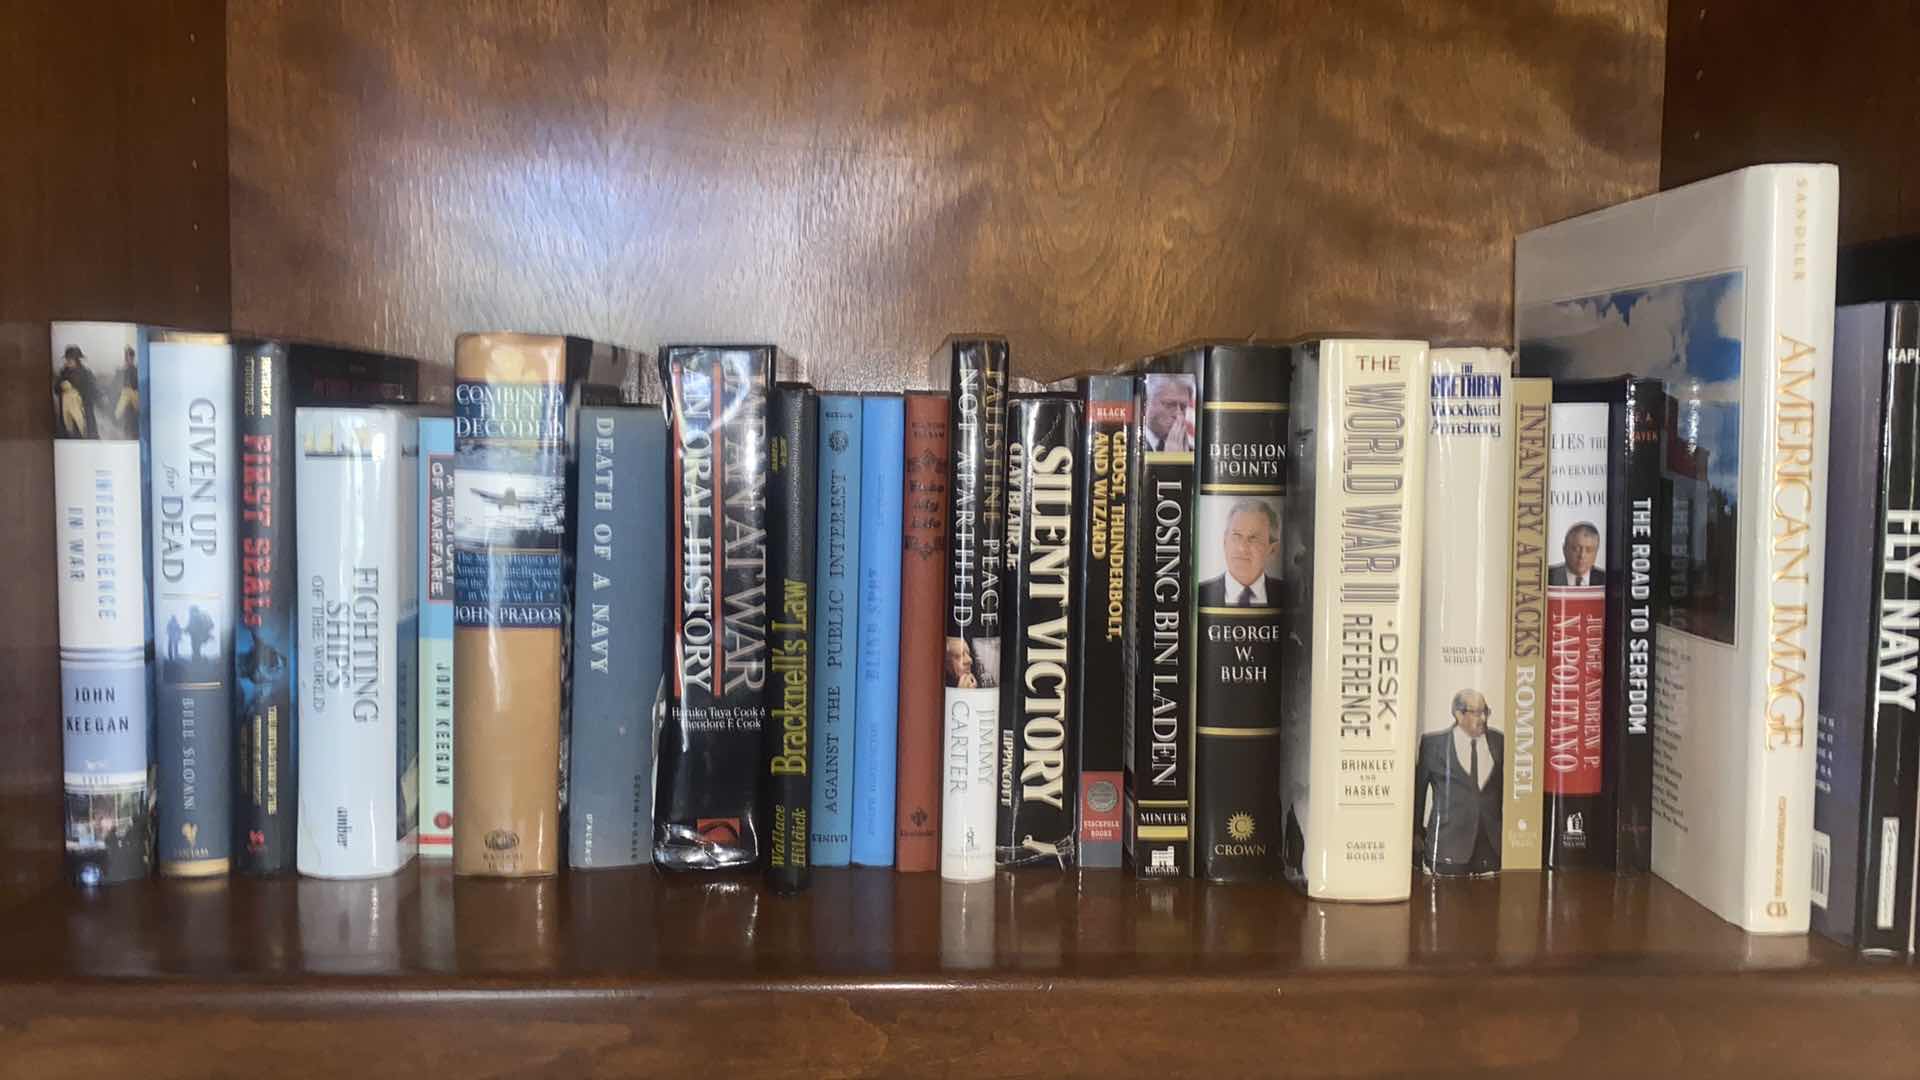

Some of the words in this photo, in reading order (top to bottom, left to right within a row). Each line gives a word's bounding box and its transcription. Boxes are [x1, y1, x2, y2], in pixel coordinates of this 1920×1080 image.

[1794, 178, 1808, 280] SANDLER
[456, 384, 565, 405] COMBINED
[683, 368, 712, 419] AN
[1356, 355, 1401, 372] THE
[1430, 374, 1502, 398] BRETHREN
[456, 417, 564, 438] DECODED
[957, 366, 978, 432] NOT
[1096, 407, 1127, 417] BLACK
[1429, 420, 1502, 438] Armstrong
[1430, 403, 1501, 418] Woodward
[188, 397, 216, 503] GIVEN
[594, 417, 614, 510] DEATH
[724, 367, 766, 510] JAPAN
[983, 370, 1004, 523] PALESTINE
[1008, 442, 1024, 490] CLAY
[1093, 431, 1110, 475] AND
[1110, 431, 1127, 500] GHOST,
[1209, 443, 1287, 458] DECISION
[1216, 461, 1279, 476] POINTS
[1343, 382, 1406, 494] WORLD
[1517, 403, 1547, 536] INFANTRY
[1773, 331, 1817, 585] AMERICAN
[162, 463, 181, 489] for
[242, 434, 272, 527] FIRST
[430, 462, 444, 491] OF
[684, 432, 712, 527] ORAL
[67, 507, 85, 529] IN
[95, 470, 117, 619] INTELLIGENCE
[160, 495, 184, 583] DEAD
[188, 513, 216, 557] UP
[429, 496, 444, 596] WARFARE
[593, 523, 612, 560] OF
[724, 516, 766, 580] AT
[829, 471, 847, 578] INTEREST
[953, 450, 977, 627] APARTHEID
[1029, 445, 1073, 608] SILENT
[1092, 478, 1109, 560] WIZARD
[1154, 480, 1183, 603] LOSING
[1340, 504, 1403, 575] WAR
[1632, 497, 1652, 538] THE
[1884, 509, 1920, 581] FLY
[69, 540, 86, 582] WAR
[312, 575, 325, 599] OF
[592, 572, 611, 590] A
[980, 538, 1000, 626] PEACE
[1105, 503, 1127, 642] THUNDERBOLT,
[1631, 544, 1651, 600] ROAD
[455, 606, 494, 623] JOHN
[500, 606, 561, 624] PRADOS
[683, 536, 712, 692] HISTORY
[772, 579, 809, 632] Law
[827, 588, 845, 669] PUBLIC
[1513, 541, 1543, 657] ATTACKS
[1630, 605, 1650, 632] TO
[326, 600, 350, 689] SHIPS
[352, 567, 379, 722] FIGHTING
[590, 603, 609, 674] NAVY
[724, 580, 766, 695] WAR
[1153, 611, 1180, 666] BIN
[1208, 625, 1280, 641] GEORGE
[1584, 613, 1602, 673] JUDGE
[1877, 600, 1920, 713] NAVY
[75, 687, 116, 701] JOHN
[312, 645, 326, 713] WORLD
[436, 664, 451, 708] JOHN
[827, 686, 841, 723] THE
[1221, 666, 1268, 682] BUSH
[1340, 613, 1373, 738] REFERENCE
[1377, 632, 1400, 720] DESK
[1550, 613, 1582, 774] NAPOLITANO
[1628, 638, 1649, 735] SERFDOM
[1764, 602, 1809, 751] IMAGE
[66, 716, 129, 732] KEEGAN
[182, 698, 195, 739] BILL
[680, 719, 726, 730] heodore
[736, 718, 761, 729] Cook
[708, 706, 732, 719] Taya
[733, 706, 759, 718] Cook
[771, 640, 808, 776] Bracknell's
[1020, 616, 1069, 811] VICTORY
[1151, 674, 1179, 788] LADEN
[1513, 664, 1537, 801] ROMMEL
[1583, 676, 1603, 749] ANDREW
[183, 746, 196, 810] SLOAN
[436, 718, 451, 785] KEEGAN
[824, 732, 841, 814] AGAINST
[949, 700, 970, 794] CARTER
[976, 709, 995, 785] JIMMY
[1001, 729, 1014, 807] LIPPINCOTT
[1341, 759, 1395, 771] BRINKLEY
[1140, 813, 1188, 824] MINITER
[1344, 785, 1391, 797] HASKEW
[772, 803, 785, 868] Wallace
[791, 807, 808, 867] Hildick
[1215, 844, 1266, 857] CROWN
[1345, 841, 1386, 850] CASTLE
[1345, 852, 1386, 862] BOOKS
